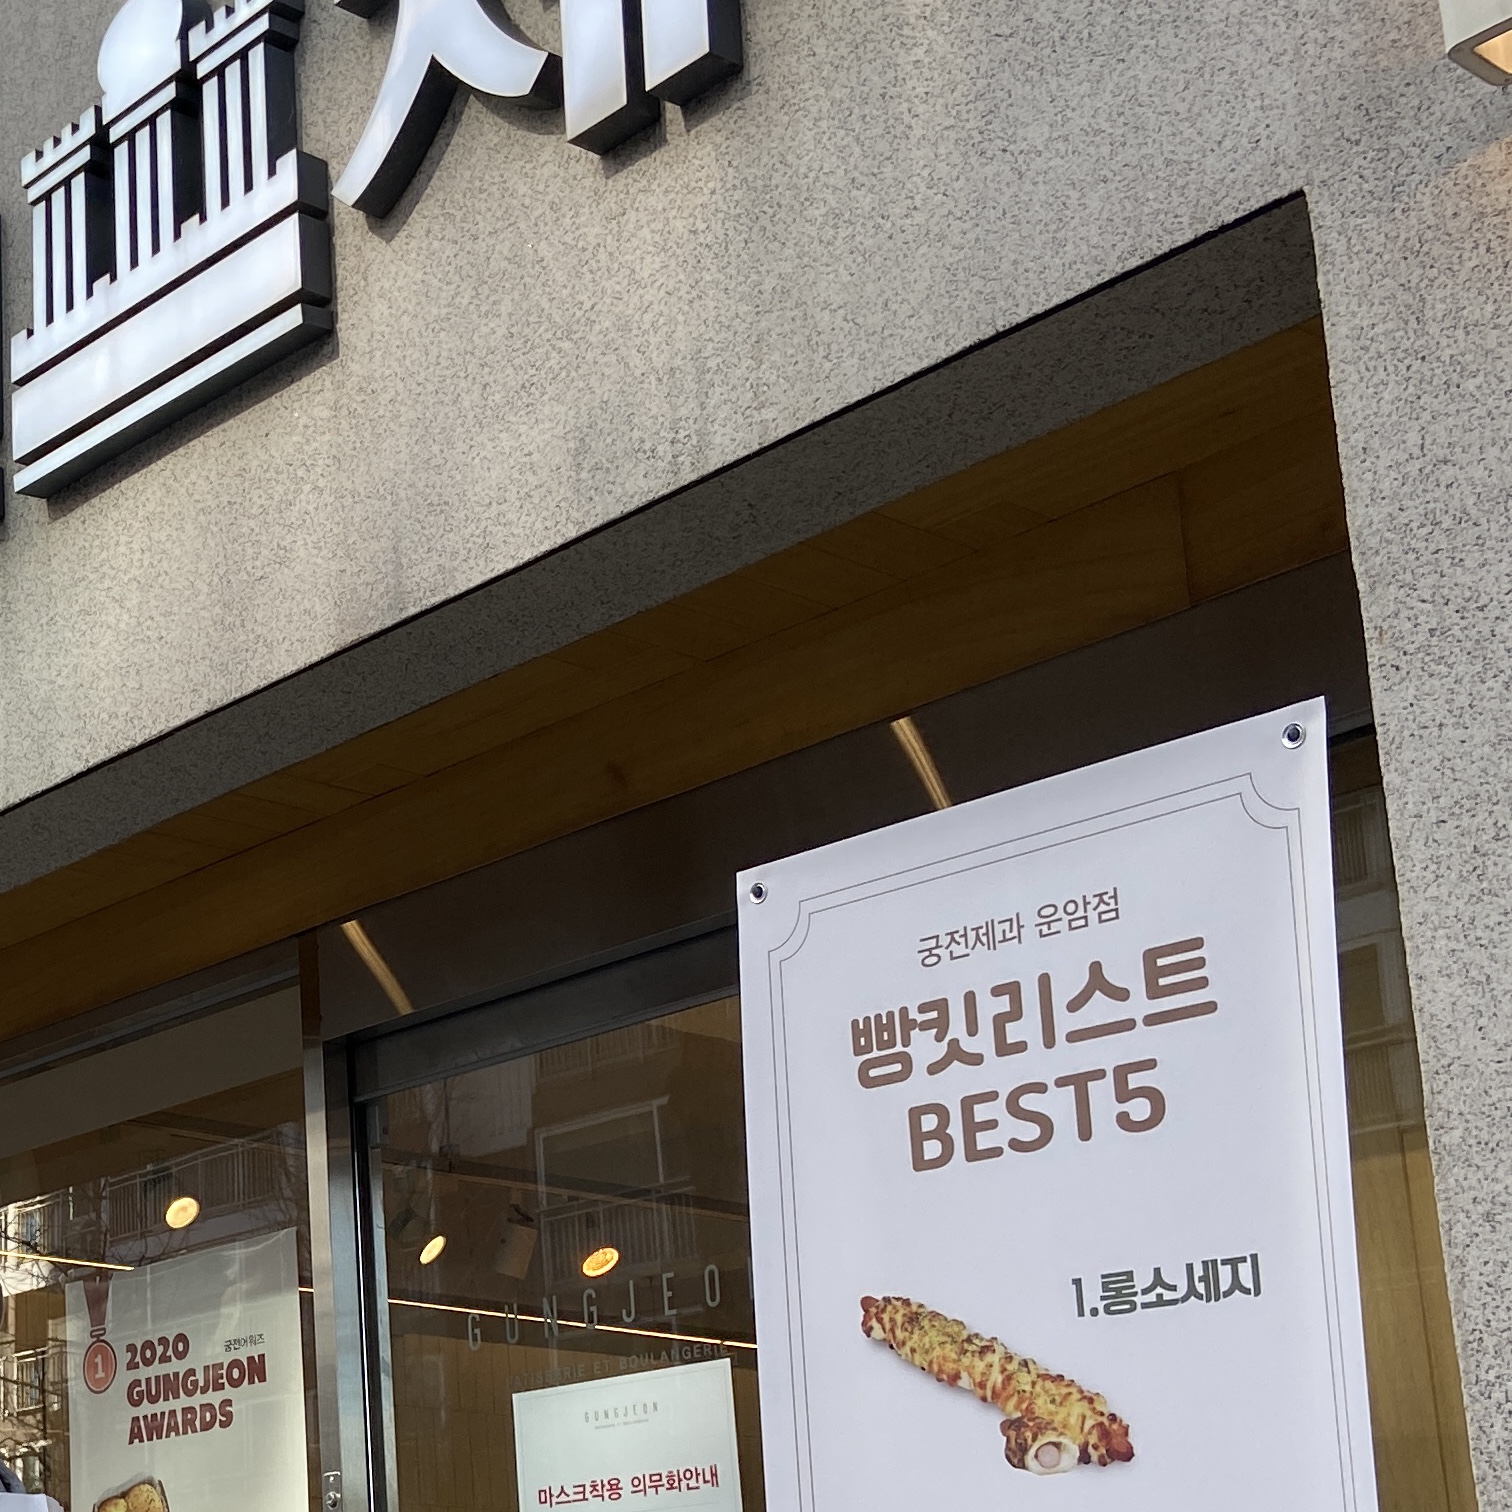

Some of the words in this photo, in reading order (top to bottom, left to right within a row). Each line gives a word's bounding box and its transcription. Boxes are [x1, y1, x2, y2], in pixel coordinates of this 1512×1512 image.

[917, 912, 1025, 967] 궁전제과
[1034, 887, 1121, 939] 운암점
[851, 936, 1218, 1089] 빵킷리스트
[907, 1058, 1166, 1172] BEST5
[467, 1256, 752, 1350] GUNGJEO
[1071, 1253, 1263, 1318] 1.롱소세지
[125, 1332, 190, 1370] 2020
[126, 1353, 267, 1407] GUNGJEON
[128, 1398, 234, 1445] AWARDS
[538, 1477, 623, 1508] 마스크착용
[630, 1463, 720, 1497] 의무화안내
